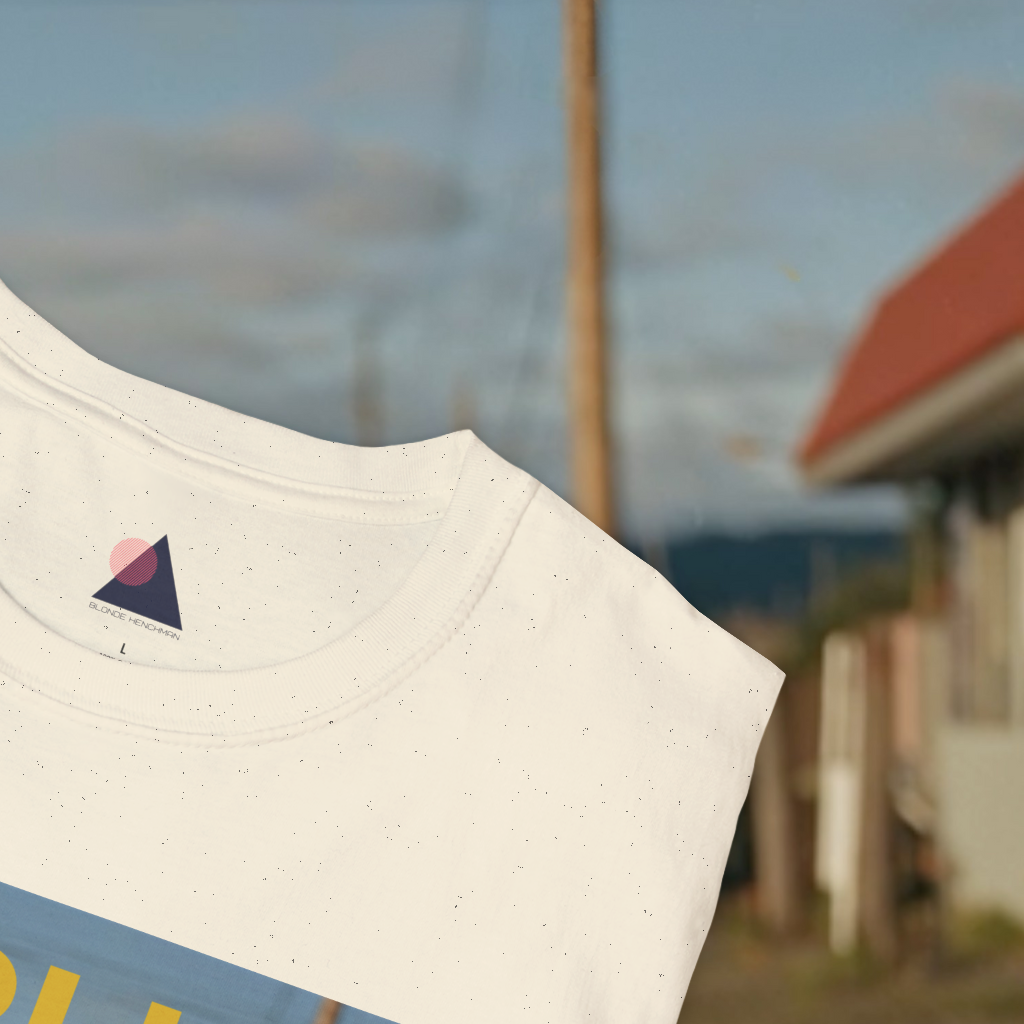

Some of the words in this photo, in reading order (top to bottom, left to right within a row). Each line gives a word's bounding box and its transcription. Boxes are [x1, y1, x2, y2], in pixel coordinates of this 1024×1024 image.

[88, 601, 127, 621] BLONDE
[128, 616, 181, 641] HENCHMAN
[119, 642, 126, 655] L
